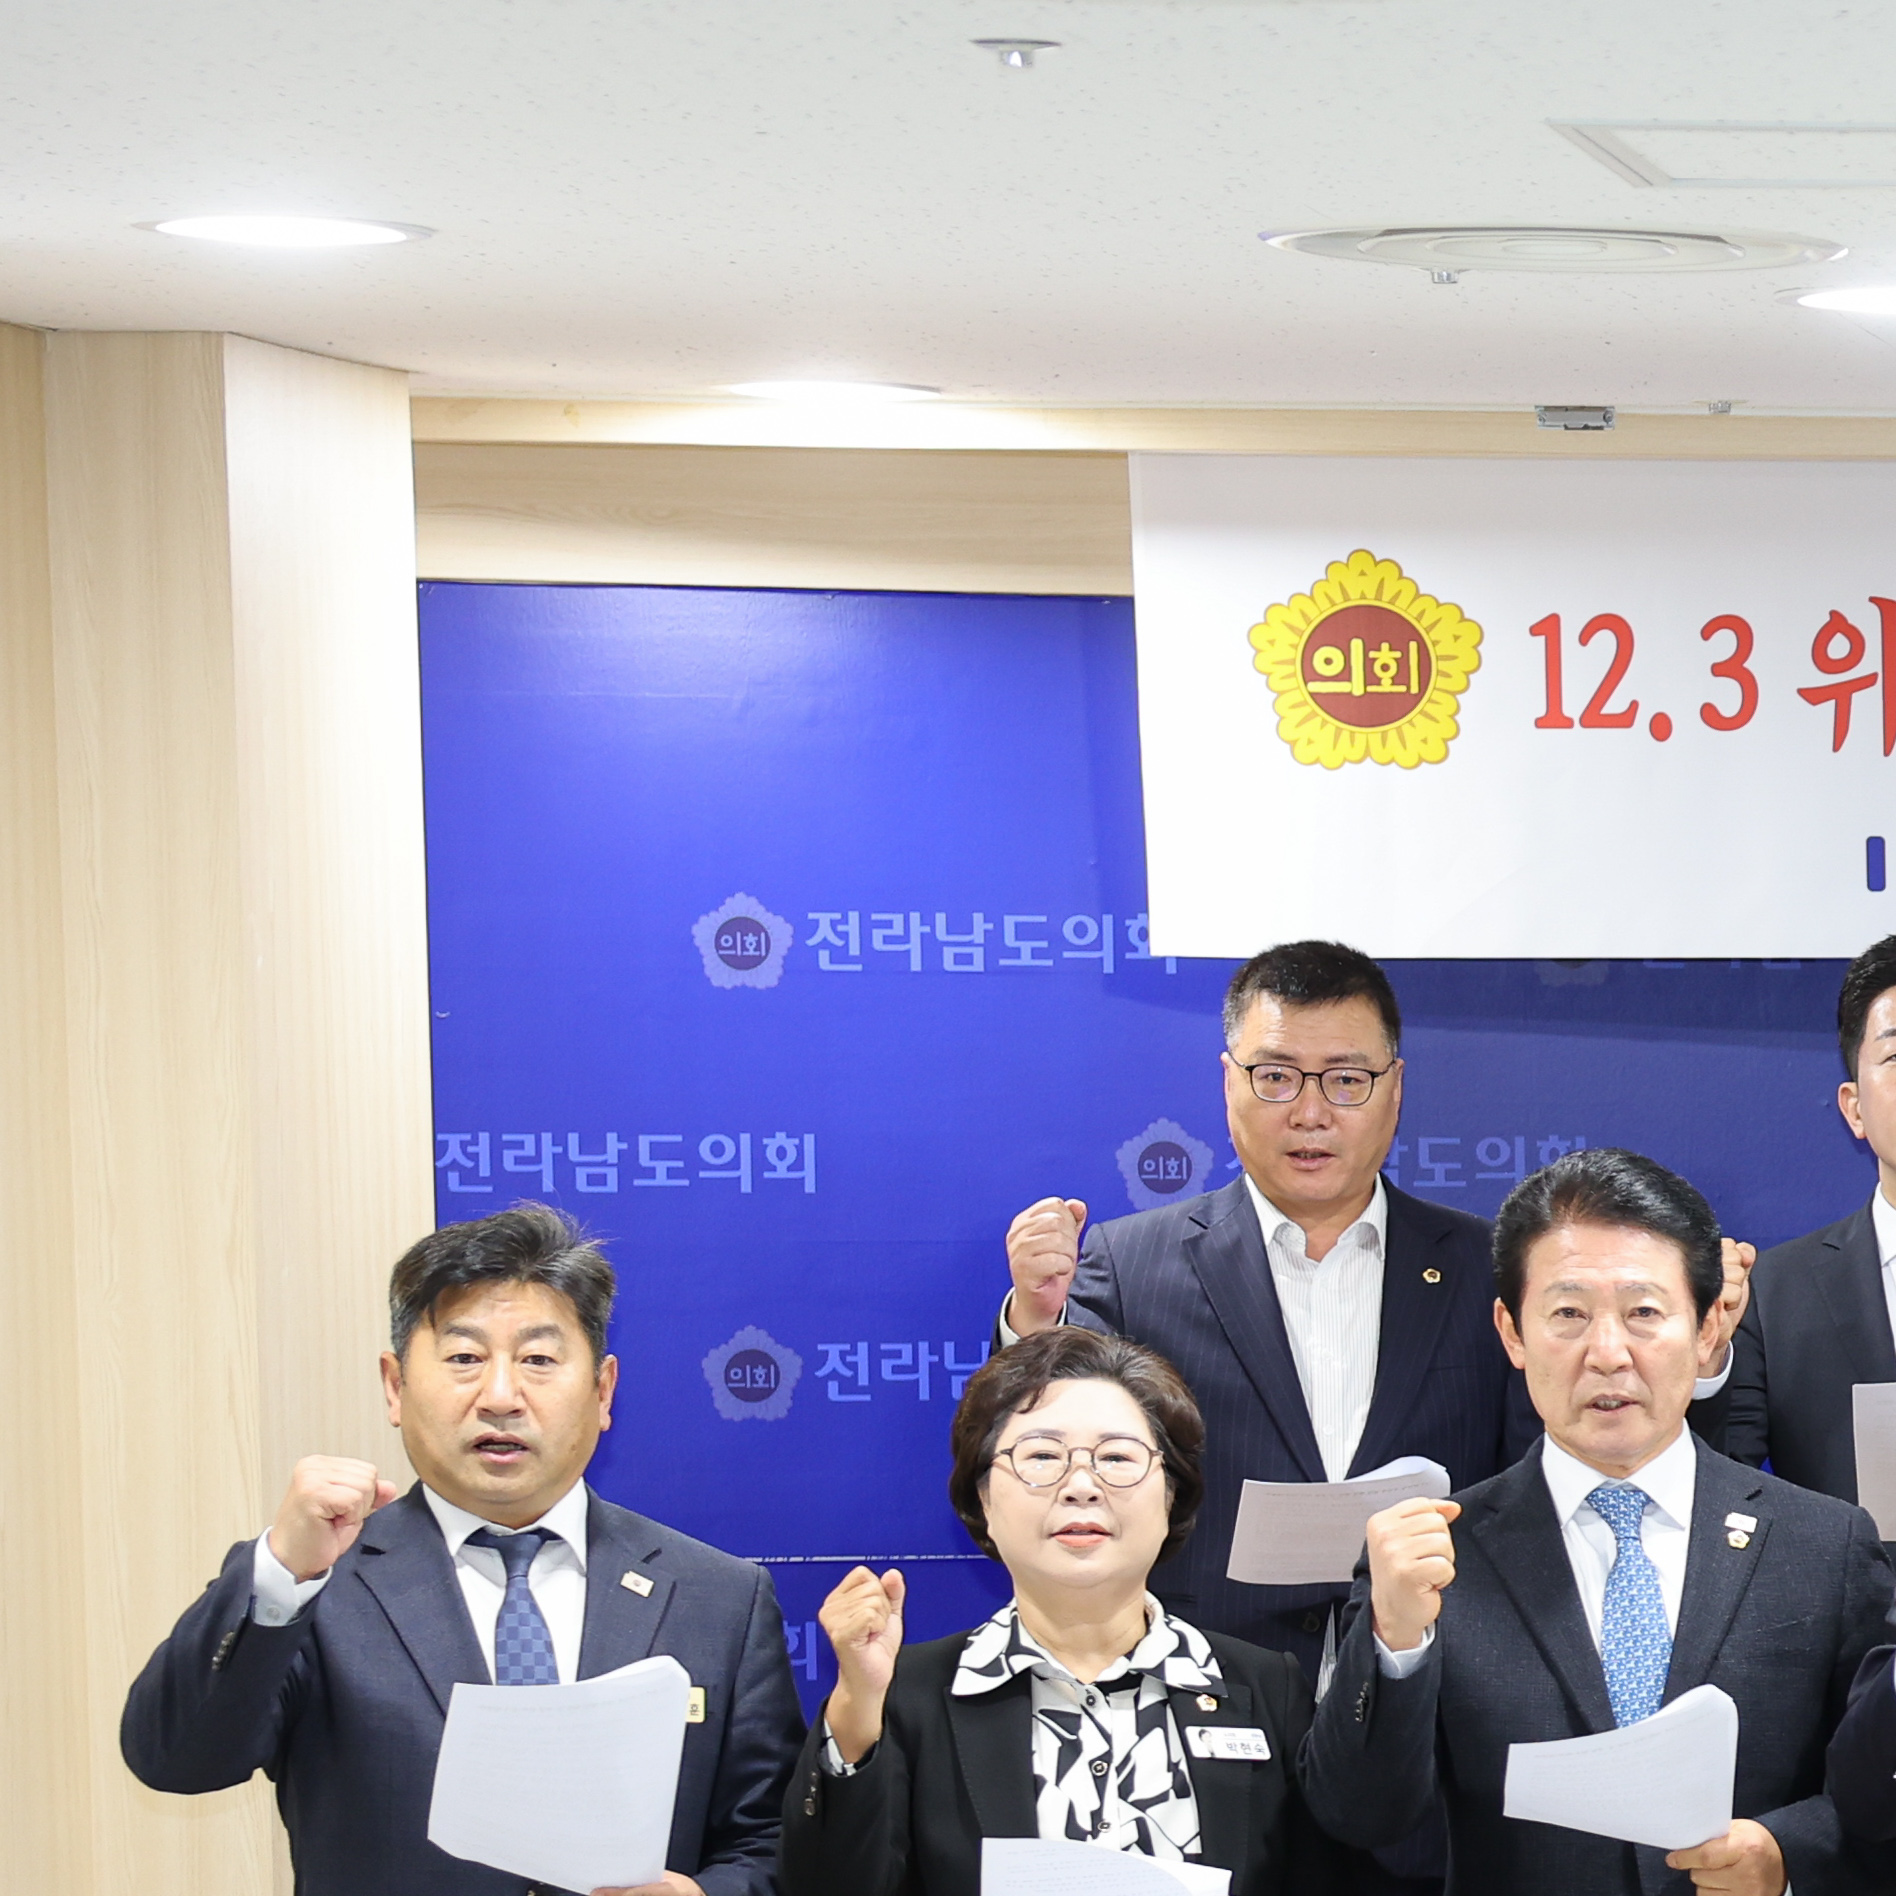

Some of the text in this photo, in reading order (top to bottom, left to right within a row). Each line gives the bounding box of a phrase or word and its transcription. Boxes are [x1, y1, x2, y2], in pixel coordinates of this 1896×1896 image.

[1306, 638, 1419, 698] 의회
[1530, 614, 1760, 743] 12.3
[718, 927, 767, 958] 의회
[434, 1131, 818, 1194] 전라남도의회
[1141, 1158, 1189, 1182] 의회
[727, 1364, 776, 1389] 의회
